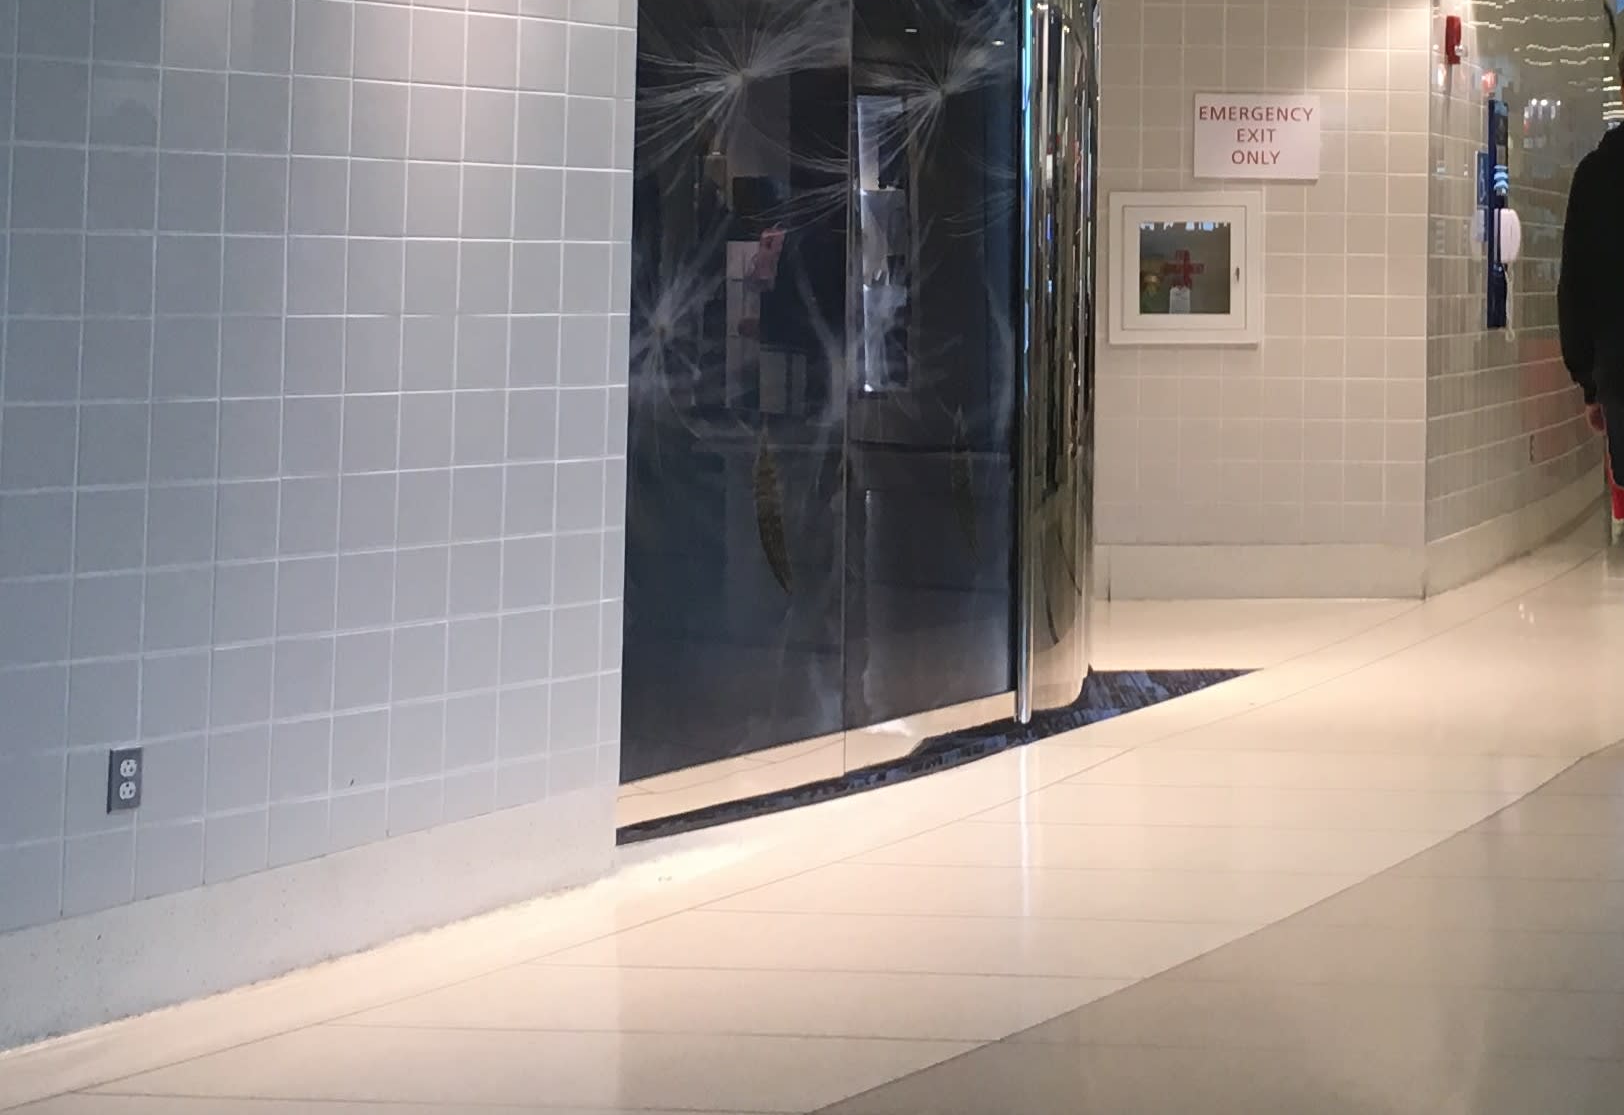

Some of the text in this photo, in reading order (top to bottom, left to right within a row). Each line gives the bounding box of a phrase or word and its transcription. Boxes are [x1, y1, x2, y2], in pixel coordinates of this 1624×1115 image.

[1199, 106, 1314, 122] EMERGENCY
[1236, 128, 1277, 143] EXIT
[1231, 149, 1281, 165] ONLY
